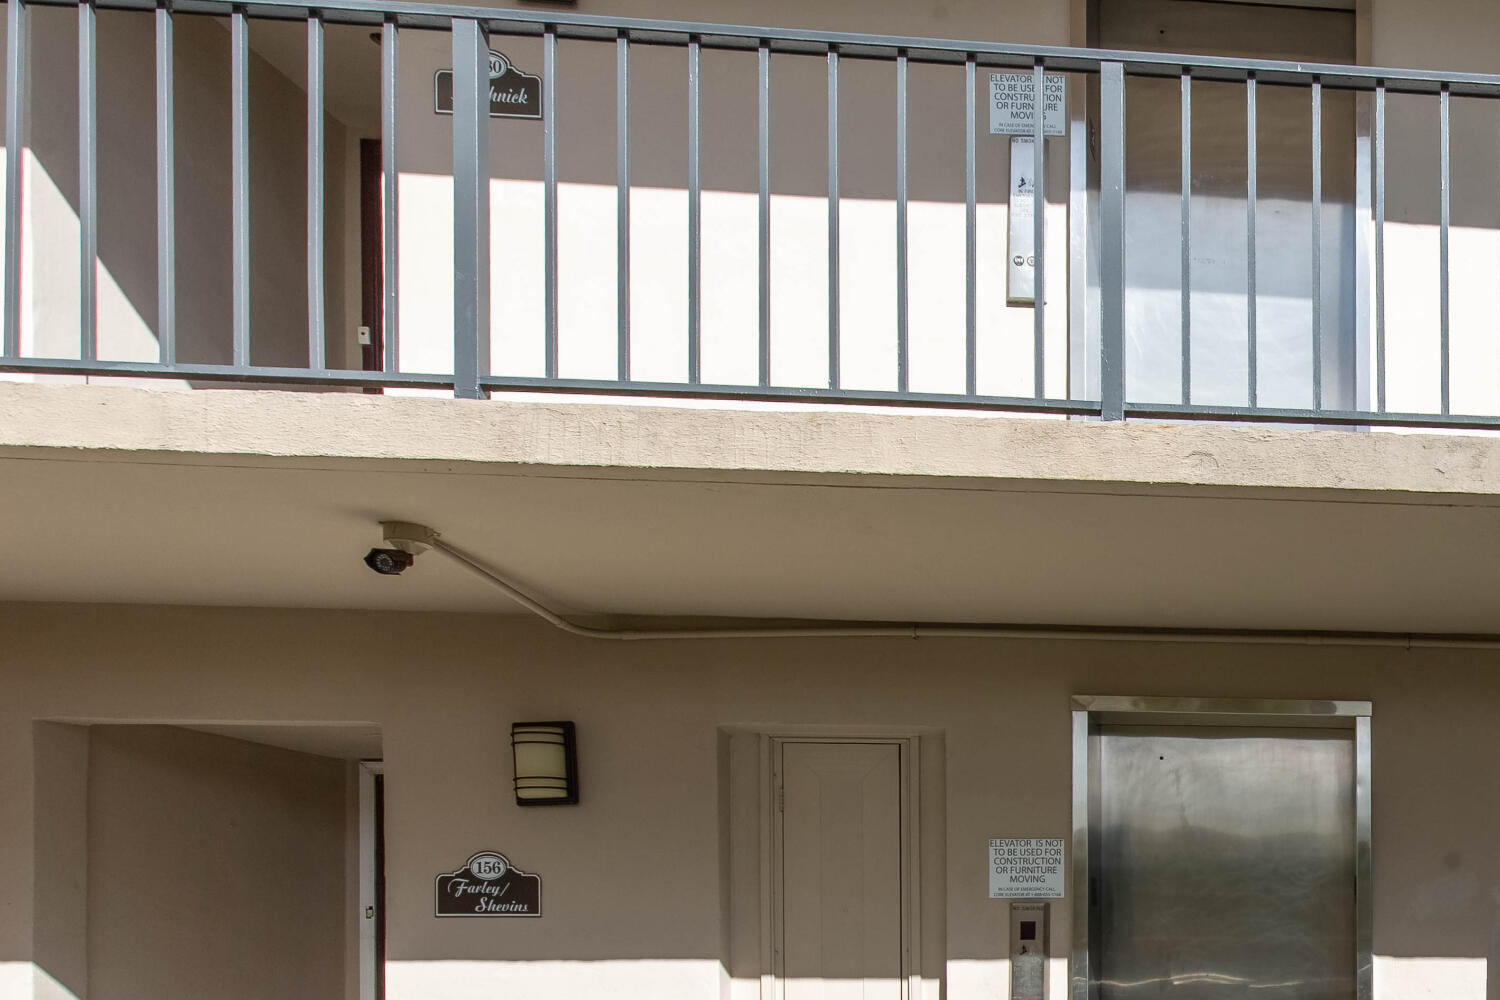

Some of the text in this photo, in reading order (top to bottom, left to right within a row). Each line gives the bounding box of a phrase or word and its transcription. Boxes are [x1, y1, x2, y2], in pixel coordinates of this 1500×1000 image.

[990, 74, 1064, 84] ELEVATOR NOT
[993, 83, 1063, 93] TO BE USE FOR
[994, 92, 1062, 102] CONSTRUION
[996, 101, 1058, 111] OR FURNURE
[1010, 111, 1047, 120] MOVIG
[990, 839, 1064, 848] ELEVATOR IS NOT
[993, 848, 1062, 857] TO BE USED FOR
[993, 857, 1061, 866] CONSTRUCTION
[475, 861, 502, 875] 156
[995, 866, 1058, 875] OR FURNITURE
[1009, 875, 1046, 883] MOVING
[447, 878, 511, 898] Farley/
[474, 896, 529, 912] Shevins
